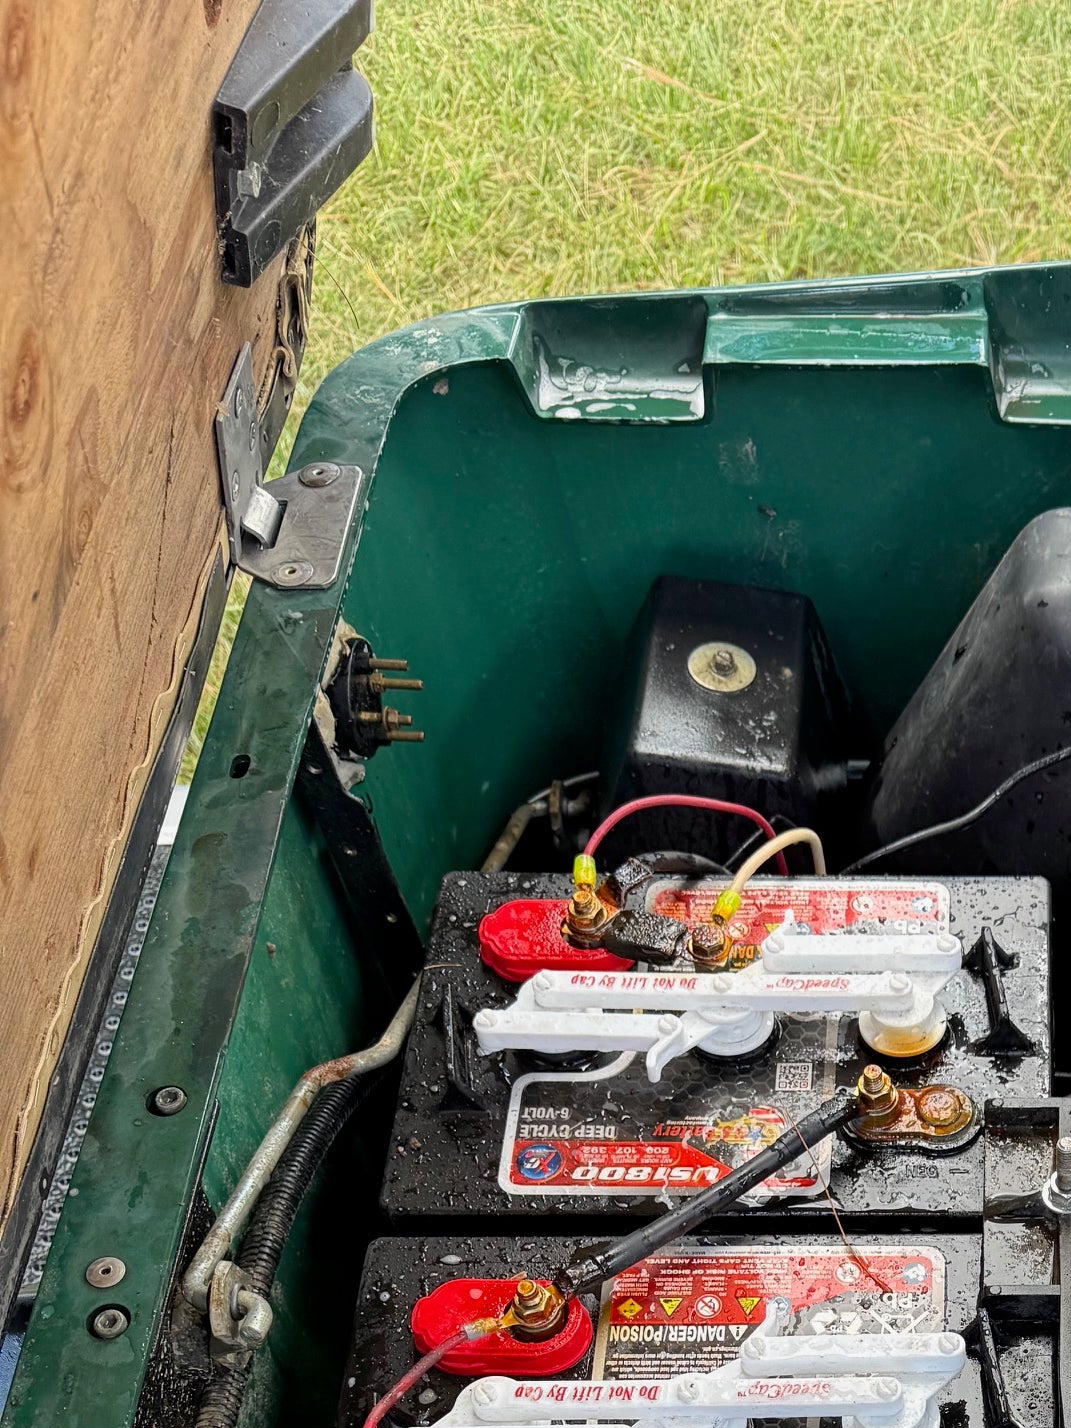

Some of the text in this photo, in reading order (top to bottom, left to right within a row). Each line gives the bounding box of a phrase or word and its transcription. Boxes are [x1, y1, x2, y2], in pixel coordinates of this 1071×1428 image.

[571, 974, 595, 987] Cap
[599, 975, 616, 990] By
[621, 977, 647, 990] Lift
[653, 977, 676, 990] Not
[680, 977, 698, 990] Do
[521, 1107, 569, 1119] 6-VOLT
[520, 1124, 616, 1138] DEEP CYCLE
[571, 1166, 720, 1181] US1800
[609, 1325, 726, 1342] DANGER/POISON
[515, 1386, 543, 1401] Cap
[547, 1385, 568, 1401] By
[572, 1386, 603, 1401] Lift
[608, 1386, 634, 1401] Not
[640, 1386, 660, 1401] Do
